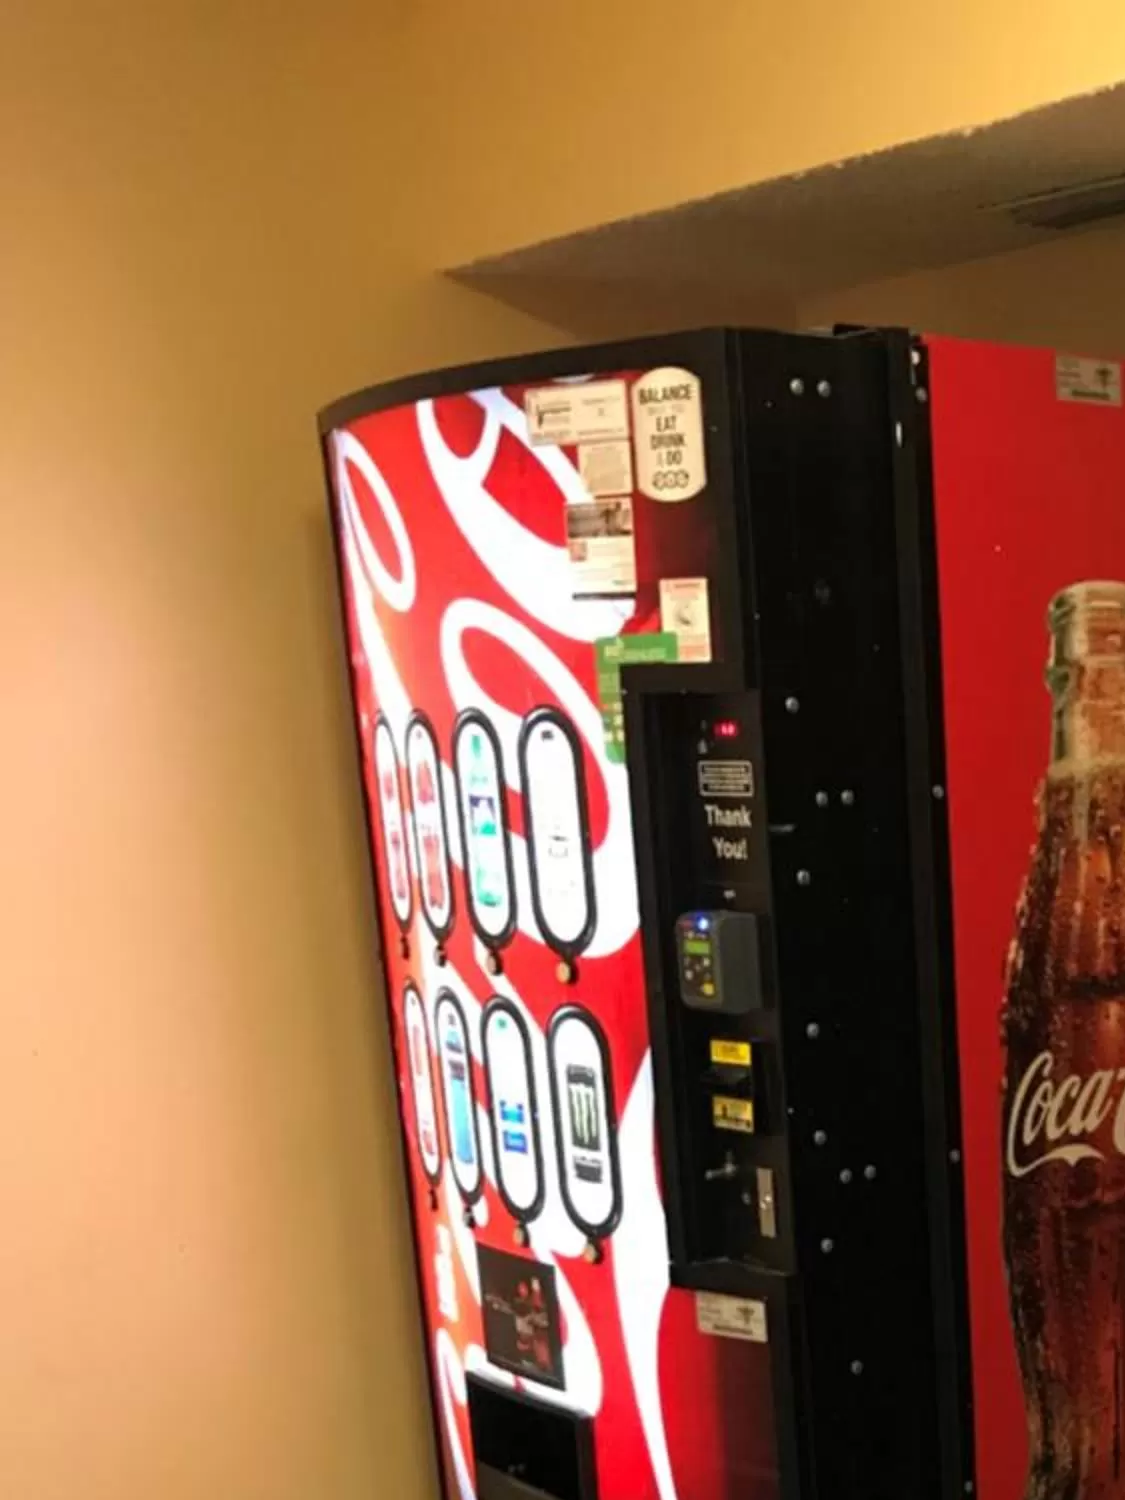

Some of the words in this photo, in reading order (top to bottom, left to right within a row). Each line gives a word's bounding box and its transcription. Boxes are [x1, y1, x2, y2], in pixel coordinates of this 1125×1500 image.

[638, 383, 692, 405] BALANCE
[655, 415, 677, 432] EAT
[650, 433, 686, 451] DRINK
[704, 804, 752, 828] Thank
[712, 836, 748, 860] You!
